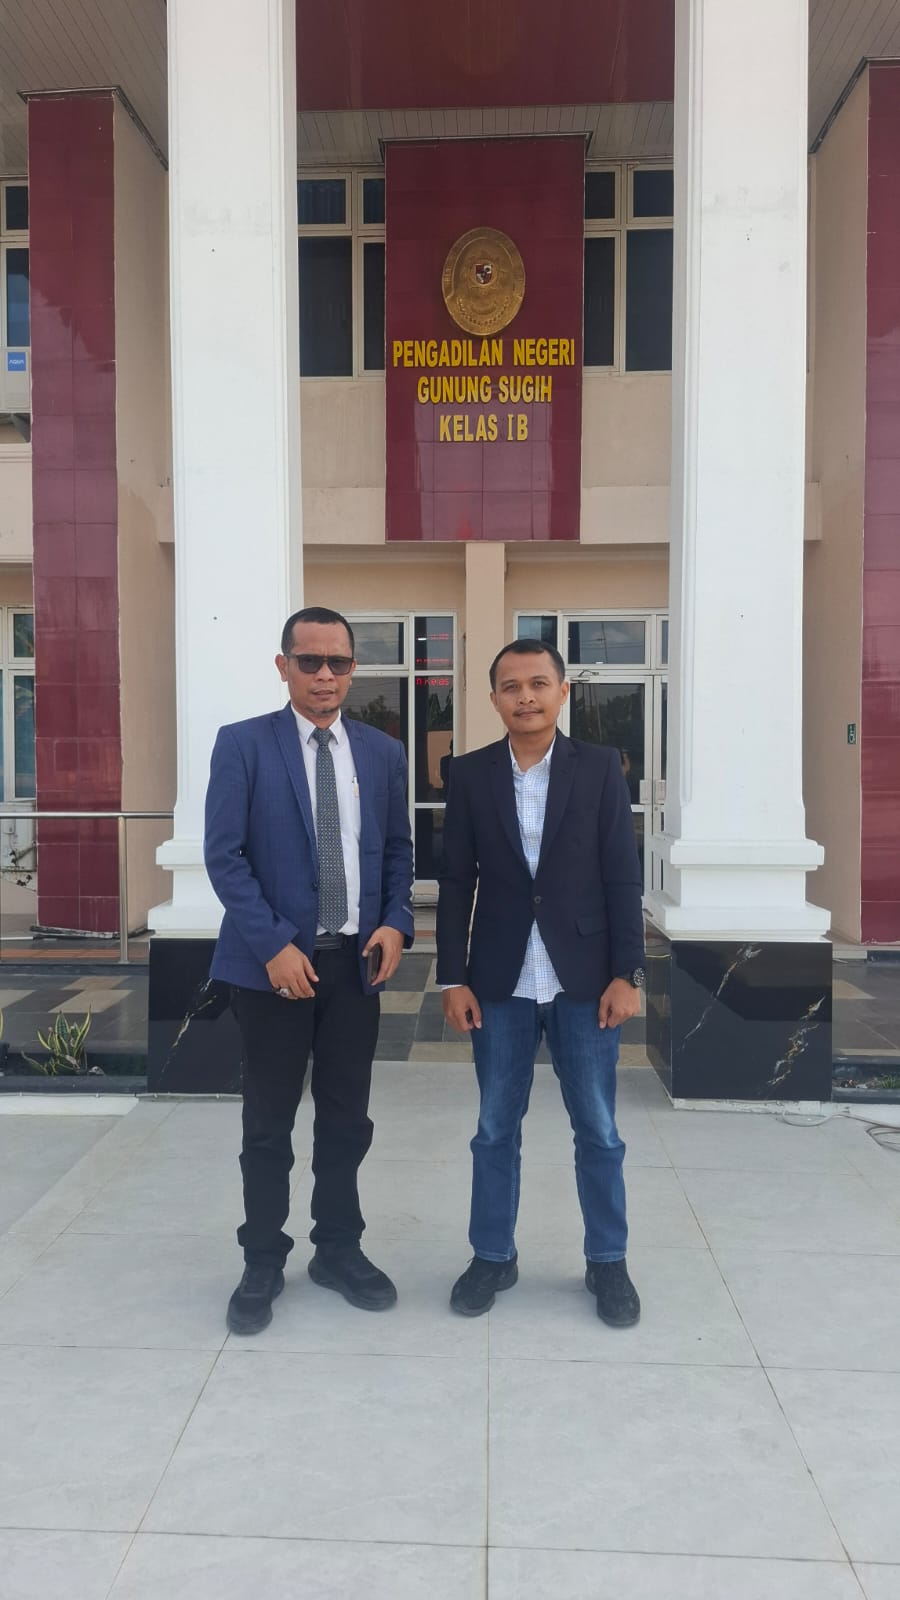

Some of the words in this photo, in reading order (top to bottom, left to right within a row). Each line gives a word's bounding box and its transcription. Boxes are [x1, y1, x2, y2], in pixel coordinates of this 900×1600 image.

[393, 339, 503, 367] PENGADILAN
[513, 338, 575, 366] NEGERI
[417, 376, 492, 404] GUNUNG
[498, 375, 553, 403] SUGIH
[439, 414, 498, 442] KELAS
